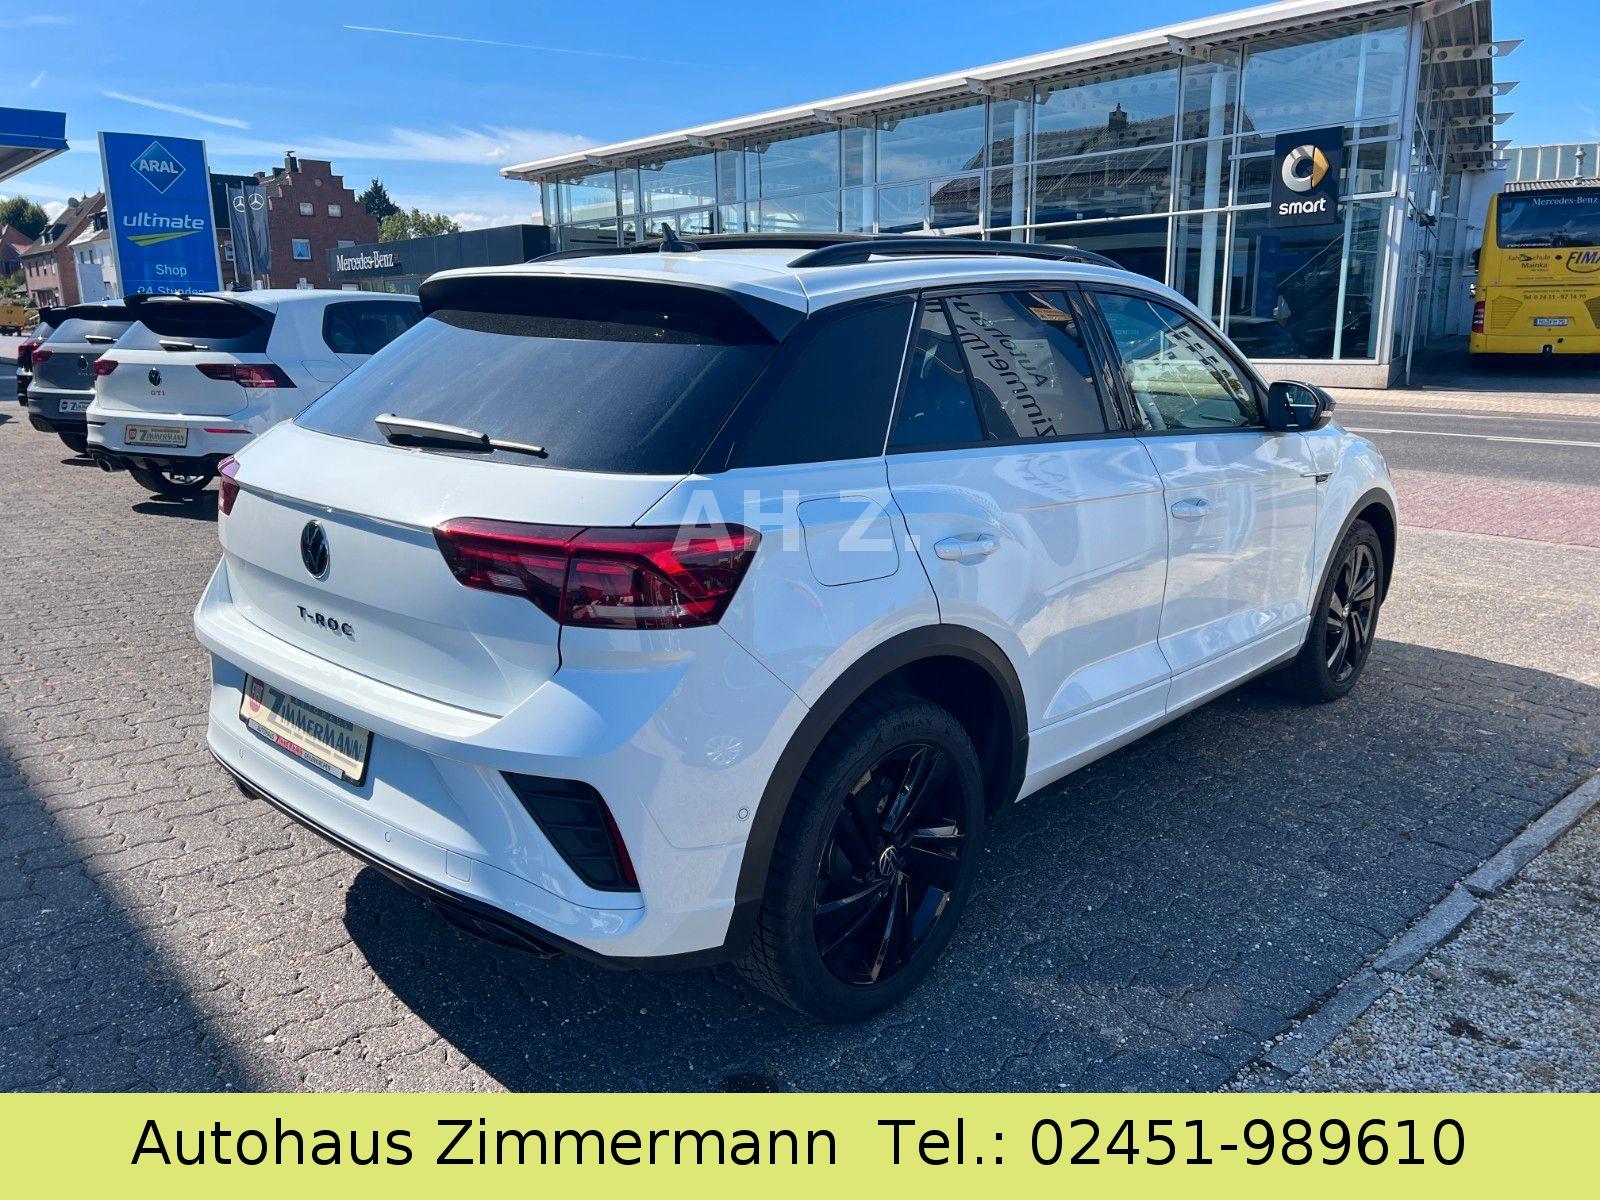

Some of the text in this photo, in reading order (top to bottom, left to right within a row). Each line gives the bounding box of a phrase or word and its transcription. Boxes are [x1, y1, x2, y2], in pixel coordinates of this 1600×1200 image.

[138, 159, 179, 174] ARAL
[1278, 197, 1327, 216] smart
[1532, 196, 1598, 207] Mercedes-Benz
[123, 212, 205, 230] ultimate
[336, 250, 394, 272] Mercedes-Benz
[155, 264, 188, 278] Shop
[297, 605, 353, 637] T-ROC
[267, 687, 363, 762] ZIMMERMANN
